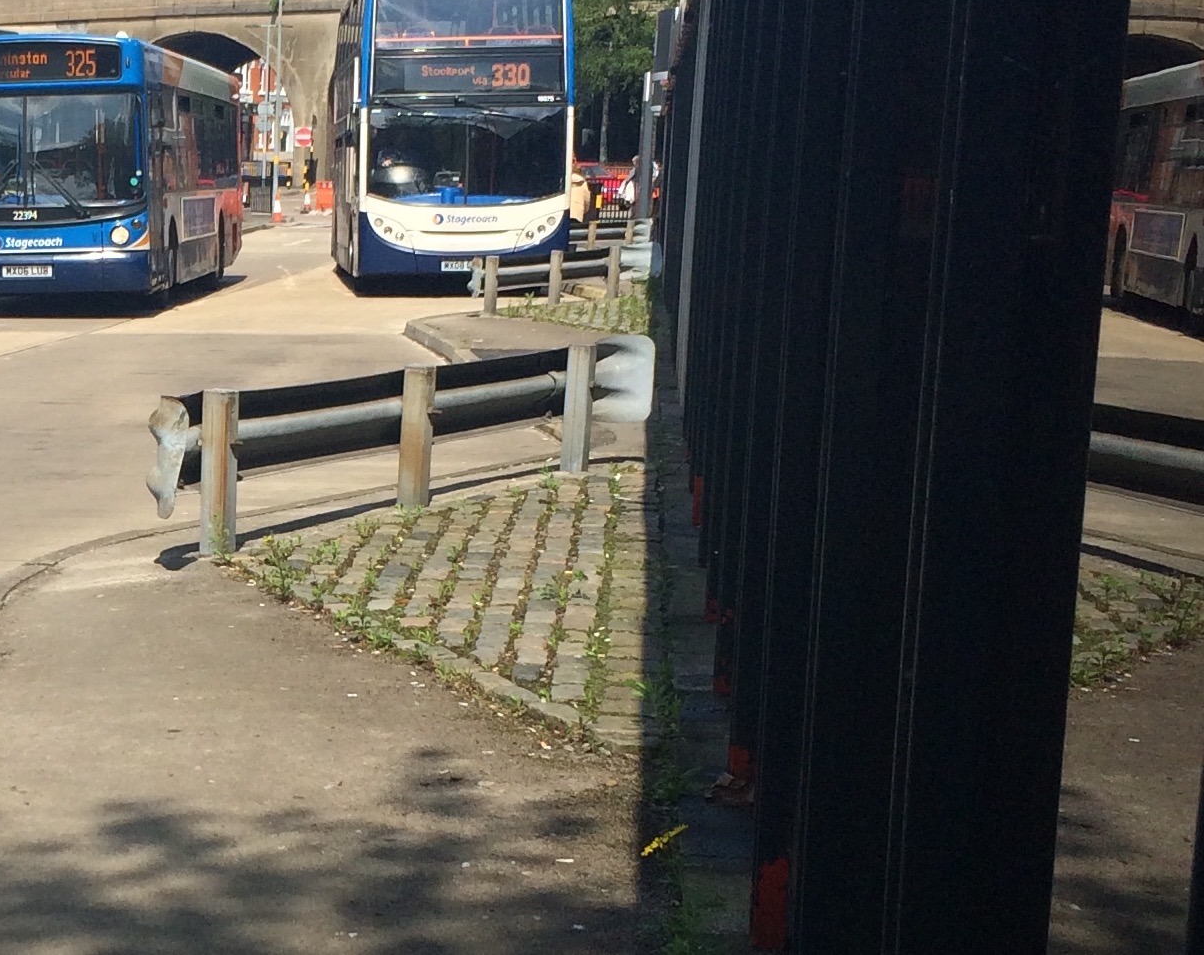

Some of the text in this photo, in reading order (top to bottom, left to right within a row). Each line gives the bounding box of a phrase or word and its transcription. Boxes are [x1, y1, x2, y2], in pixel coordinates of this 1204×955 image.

[65, 49, 96, 77] 325
[491, 63, 530, 87] 330
[447, 215, 498, 225] Stagecoach
[5, 237, 63, 250] Stagecoach
[6, 266, 29, 276] MX06
